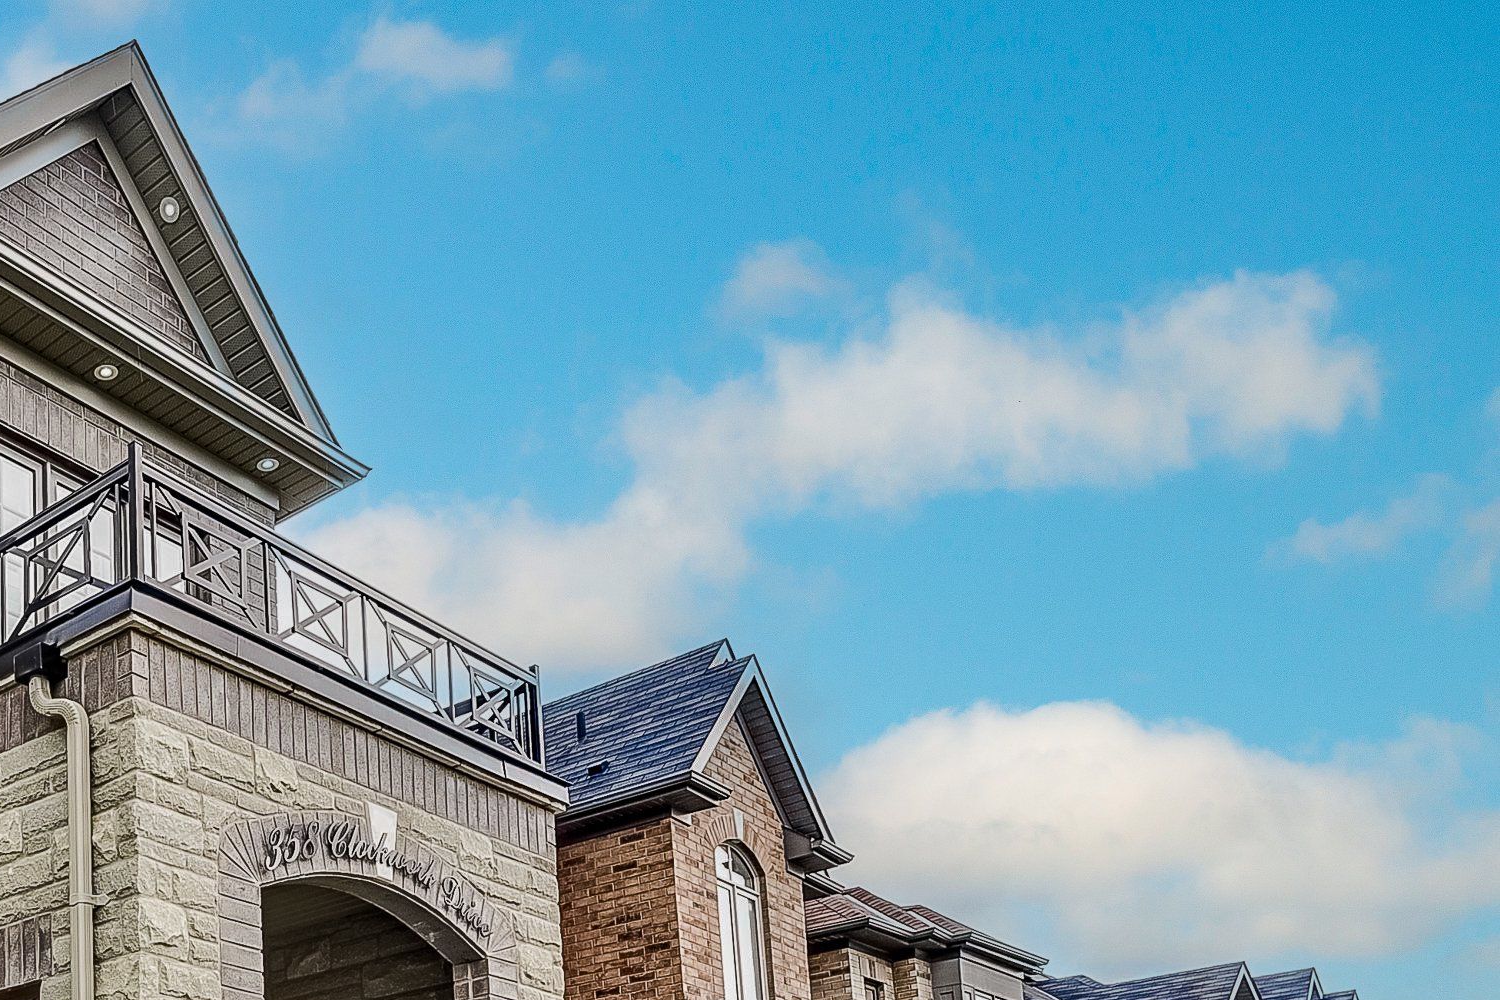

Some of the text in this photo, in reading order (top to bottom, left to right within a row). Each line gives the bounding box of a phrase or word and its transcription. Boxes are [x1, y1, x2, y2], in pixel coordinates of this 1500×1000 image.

[265, 820, 494, 938] 358 Clockwork Drive
